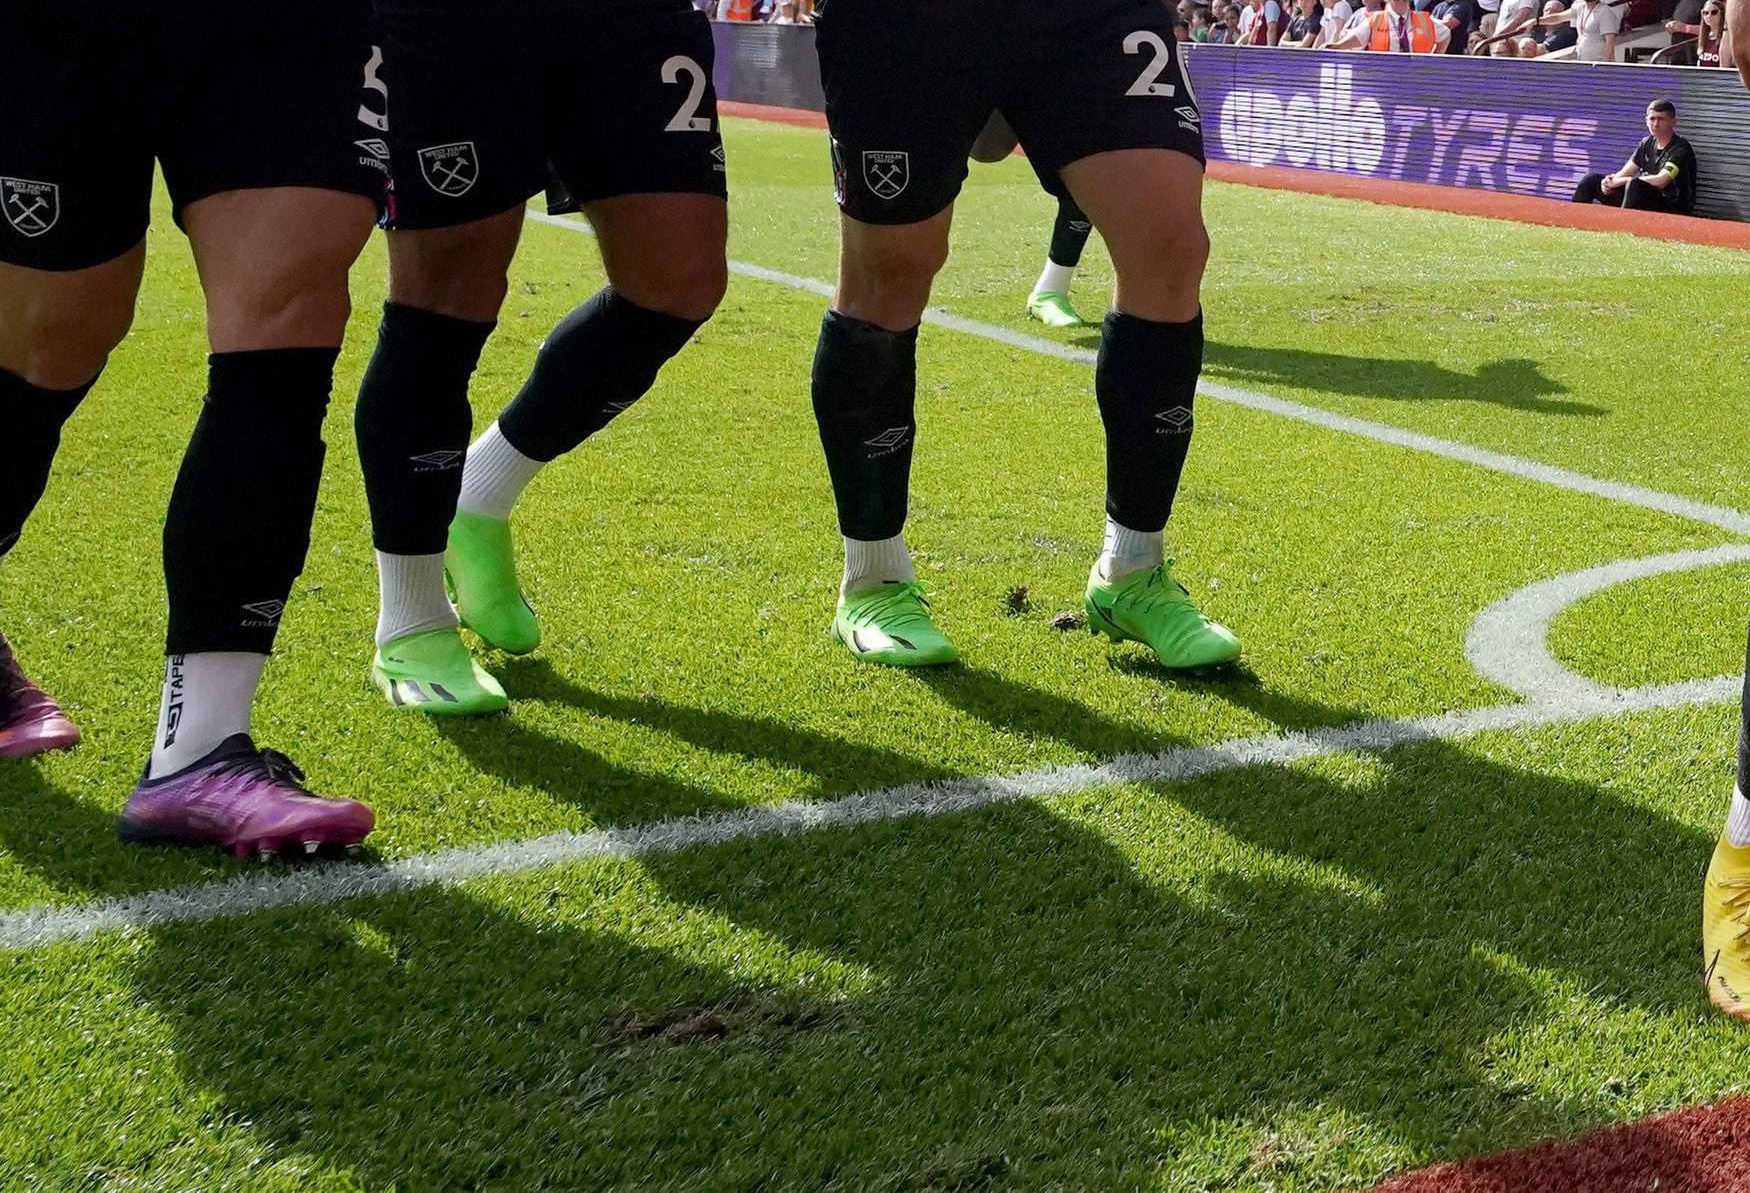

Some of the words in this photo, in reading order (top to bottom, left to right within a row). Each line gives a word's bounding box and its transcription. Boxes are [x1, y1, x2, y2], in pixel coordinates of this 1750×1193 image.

[661, 55, 711, 132] 2
[1123, 30, 1200, 110] 2
[1220, 63, 1386, 178] apollo
[1391, 104, 1599, 201] TYRES
